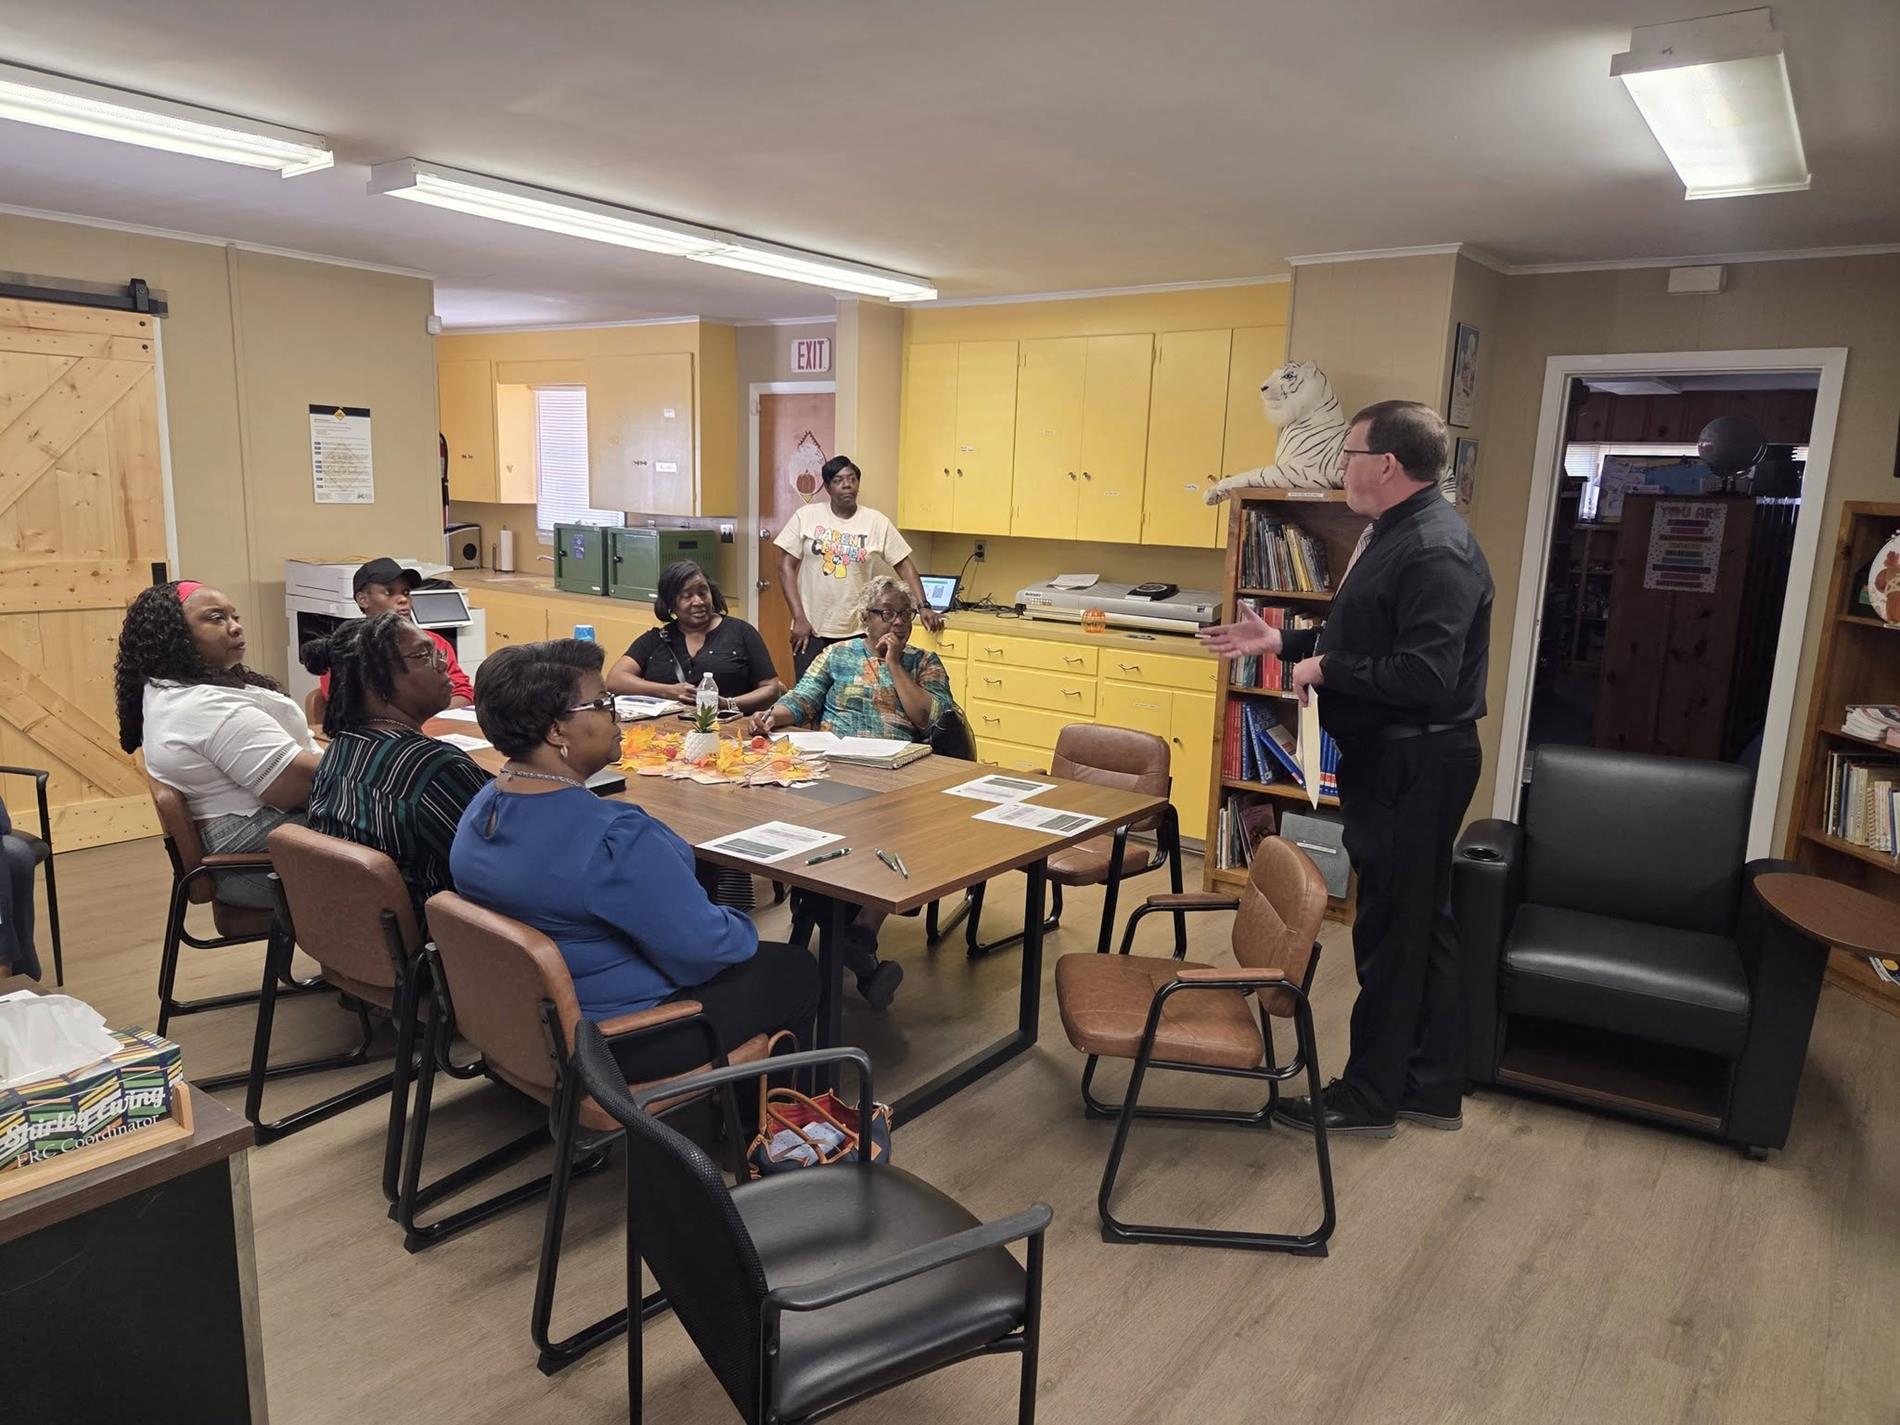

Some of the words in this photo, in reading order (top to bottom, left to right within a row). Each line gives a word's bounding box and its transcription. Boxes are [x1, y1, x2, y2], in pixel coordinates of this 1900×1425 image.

[797, 340, 824, 370] EXIT
[814, 525, 868, 548] PARENT
[811, 539, 867, 563] CENTER
[17, 1144, 57, 1168] FRC
[61, 1115, 159, 1153] Coordinator
